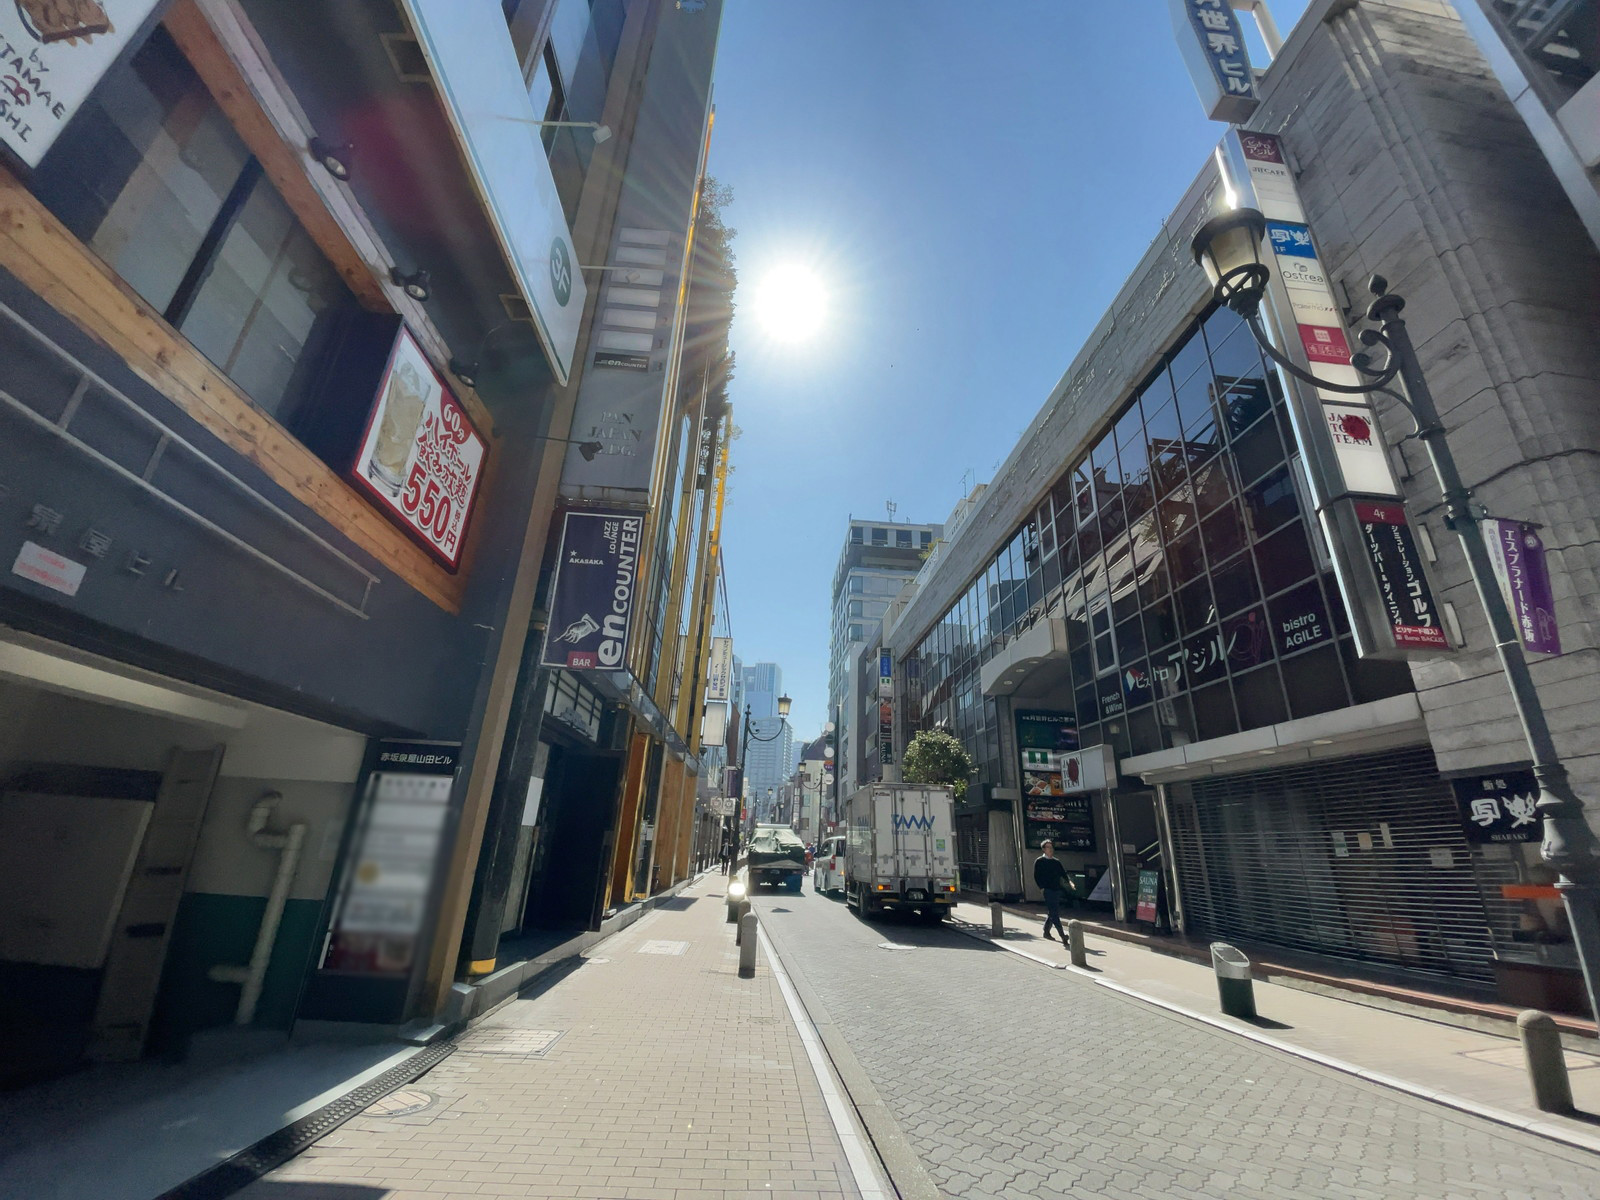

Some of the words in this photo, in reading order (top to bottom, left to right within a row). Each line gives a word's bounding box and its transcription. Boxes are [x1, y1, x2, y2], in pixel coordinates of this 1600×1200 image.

[0, 34, 66, 120] TAMAE
[551, 250, 571, 295] 3F
[1283, 270, 1324, 284] Ostrea
[417, 410, 472, 483] ハイボール
[417, 439, 469, 507] 飲み放題
[1373, 508, 1385, 520] 4F
[603, 520, 613, 539] JAZZ
[608, 521, 620, 554] LOUNGE
[568, 557, 604, 565] AKASAKA
[1504, 529, 1536, 643] エスプラナード赤坂
[1282, 611, 1317, 633] bistro
[1285, 625, 1323, 648] AGILE
[572, 657, 591, 667] BAR
[1101, 691, 1121, 704] French
[1104, 702, 1123, 715] &Wine
[380, 752, 453, 765] 赤坂泉屋山田ビル
[1470, 792, 1537, 829] 写楽
[1491, 833, 1529, 841] SHARAKU
[1139, 876, 1158, 886] SAUNA
